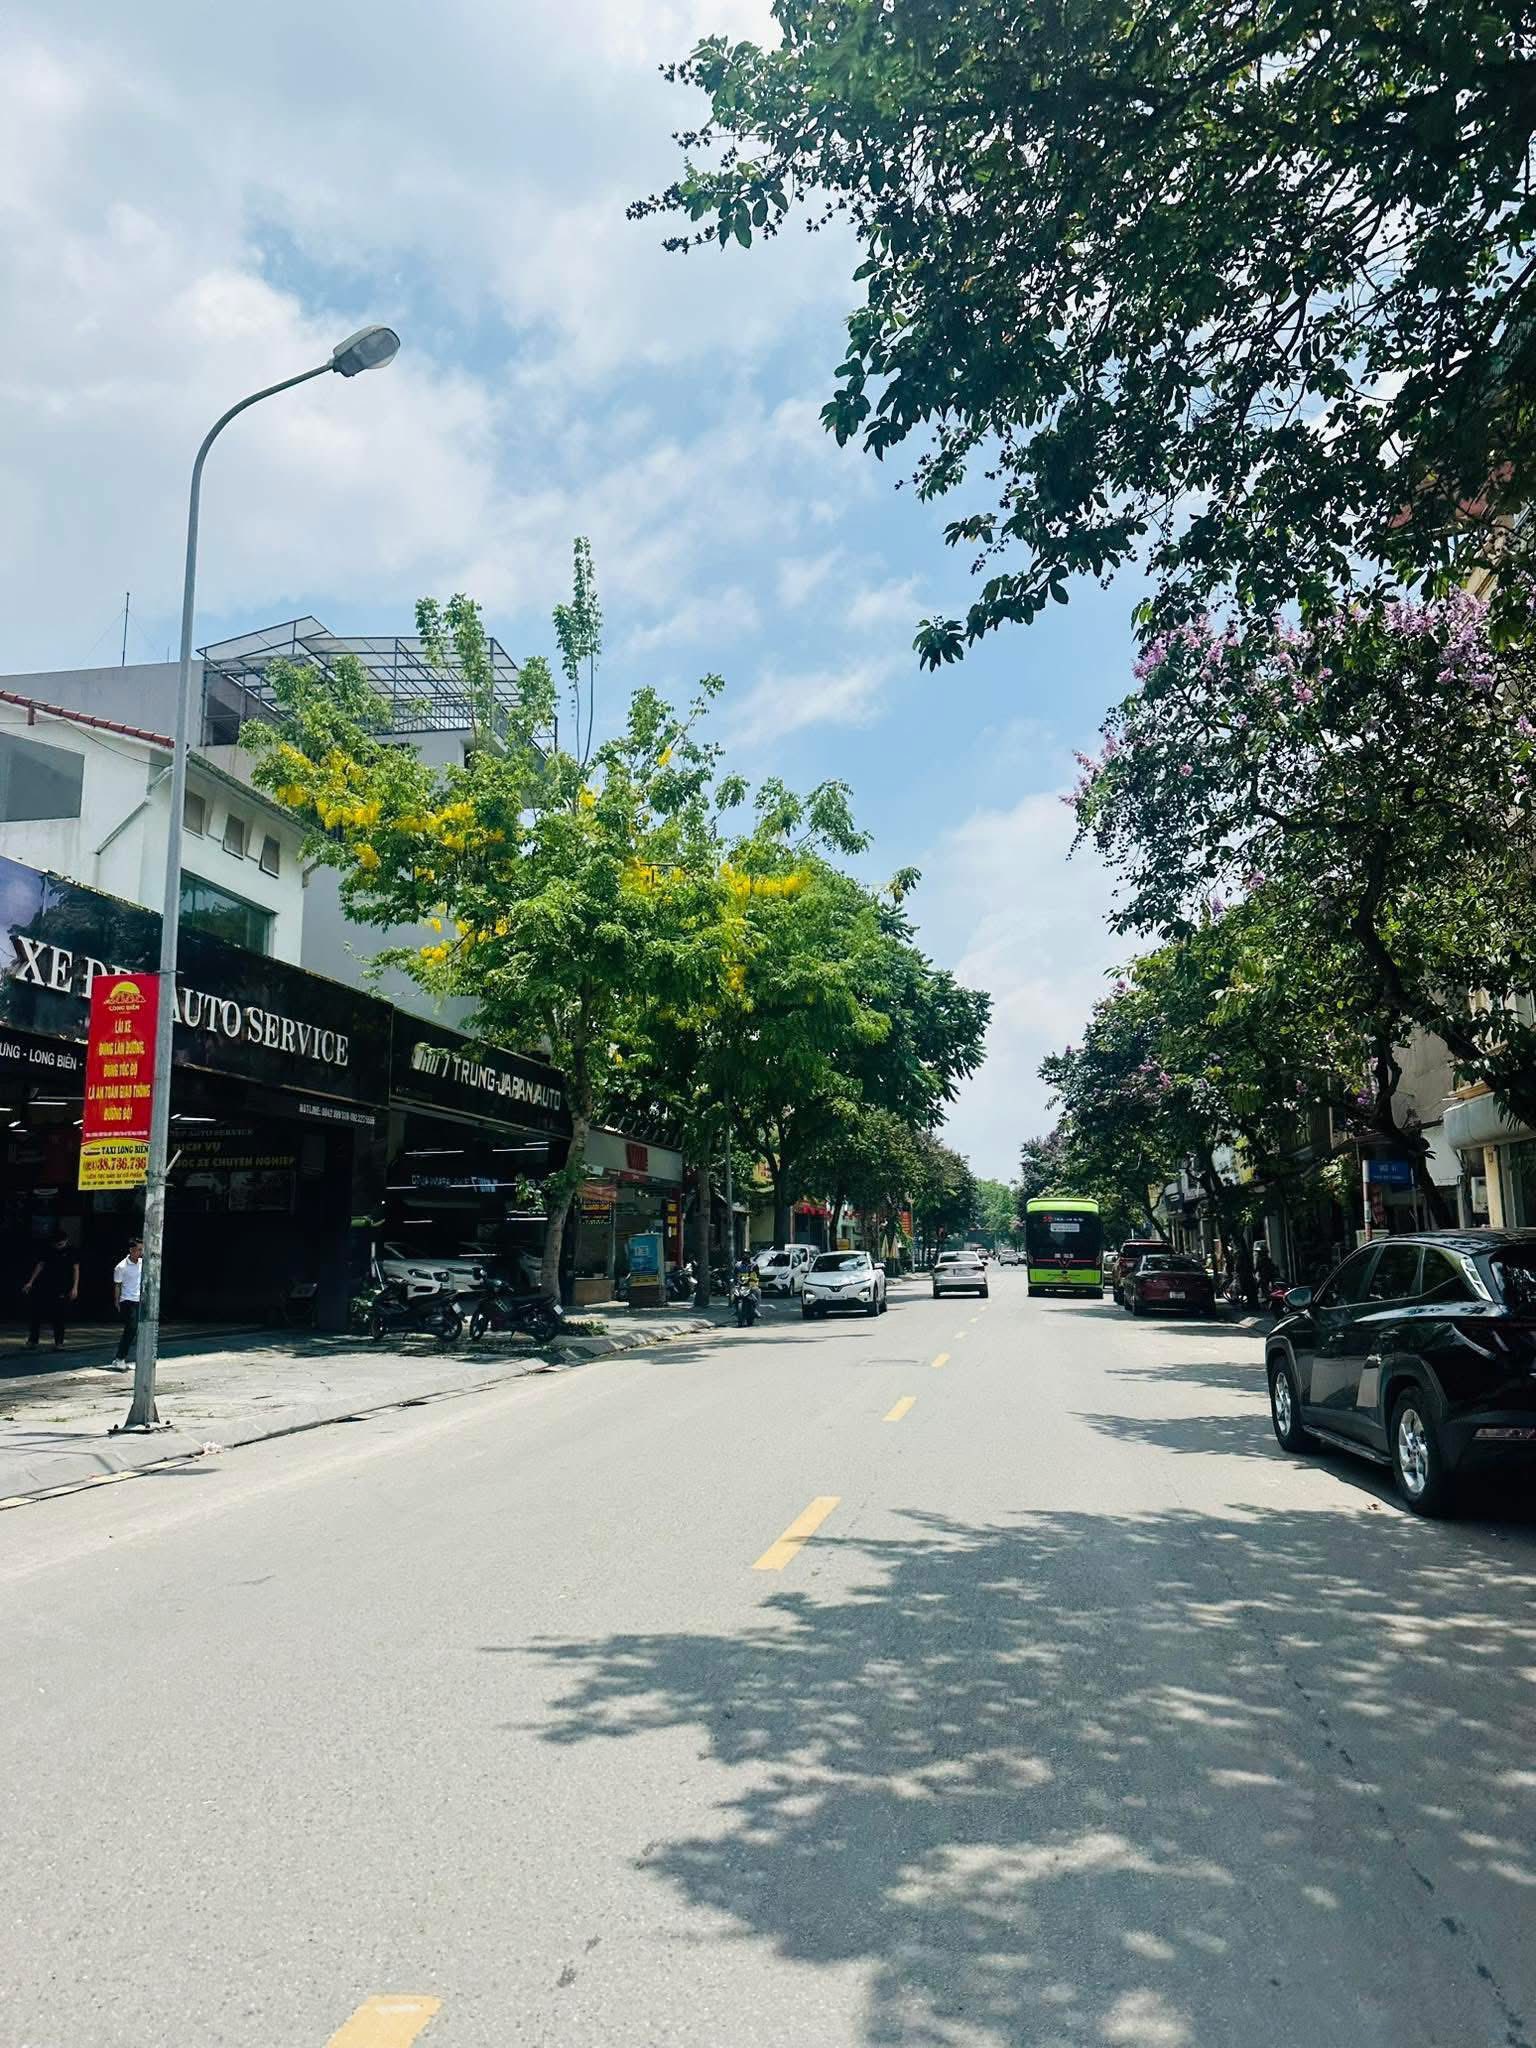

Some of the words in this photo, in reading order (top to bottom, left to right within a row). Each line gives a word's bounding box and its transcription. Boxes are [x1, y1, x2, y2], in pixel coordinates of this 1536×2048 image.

[16, 935, 73, 993] XE
[247, 1006, 349, 1067] SERVICE
[29, 1048, 55, 1066] LONG
[57, 1053, 77, 1070] BIÊN
[117, 1146, 133, 1154] LONG
